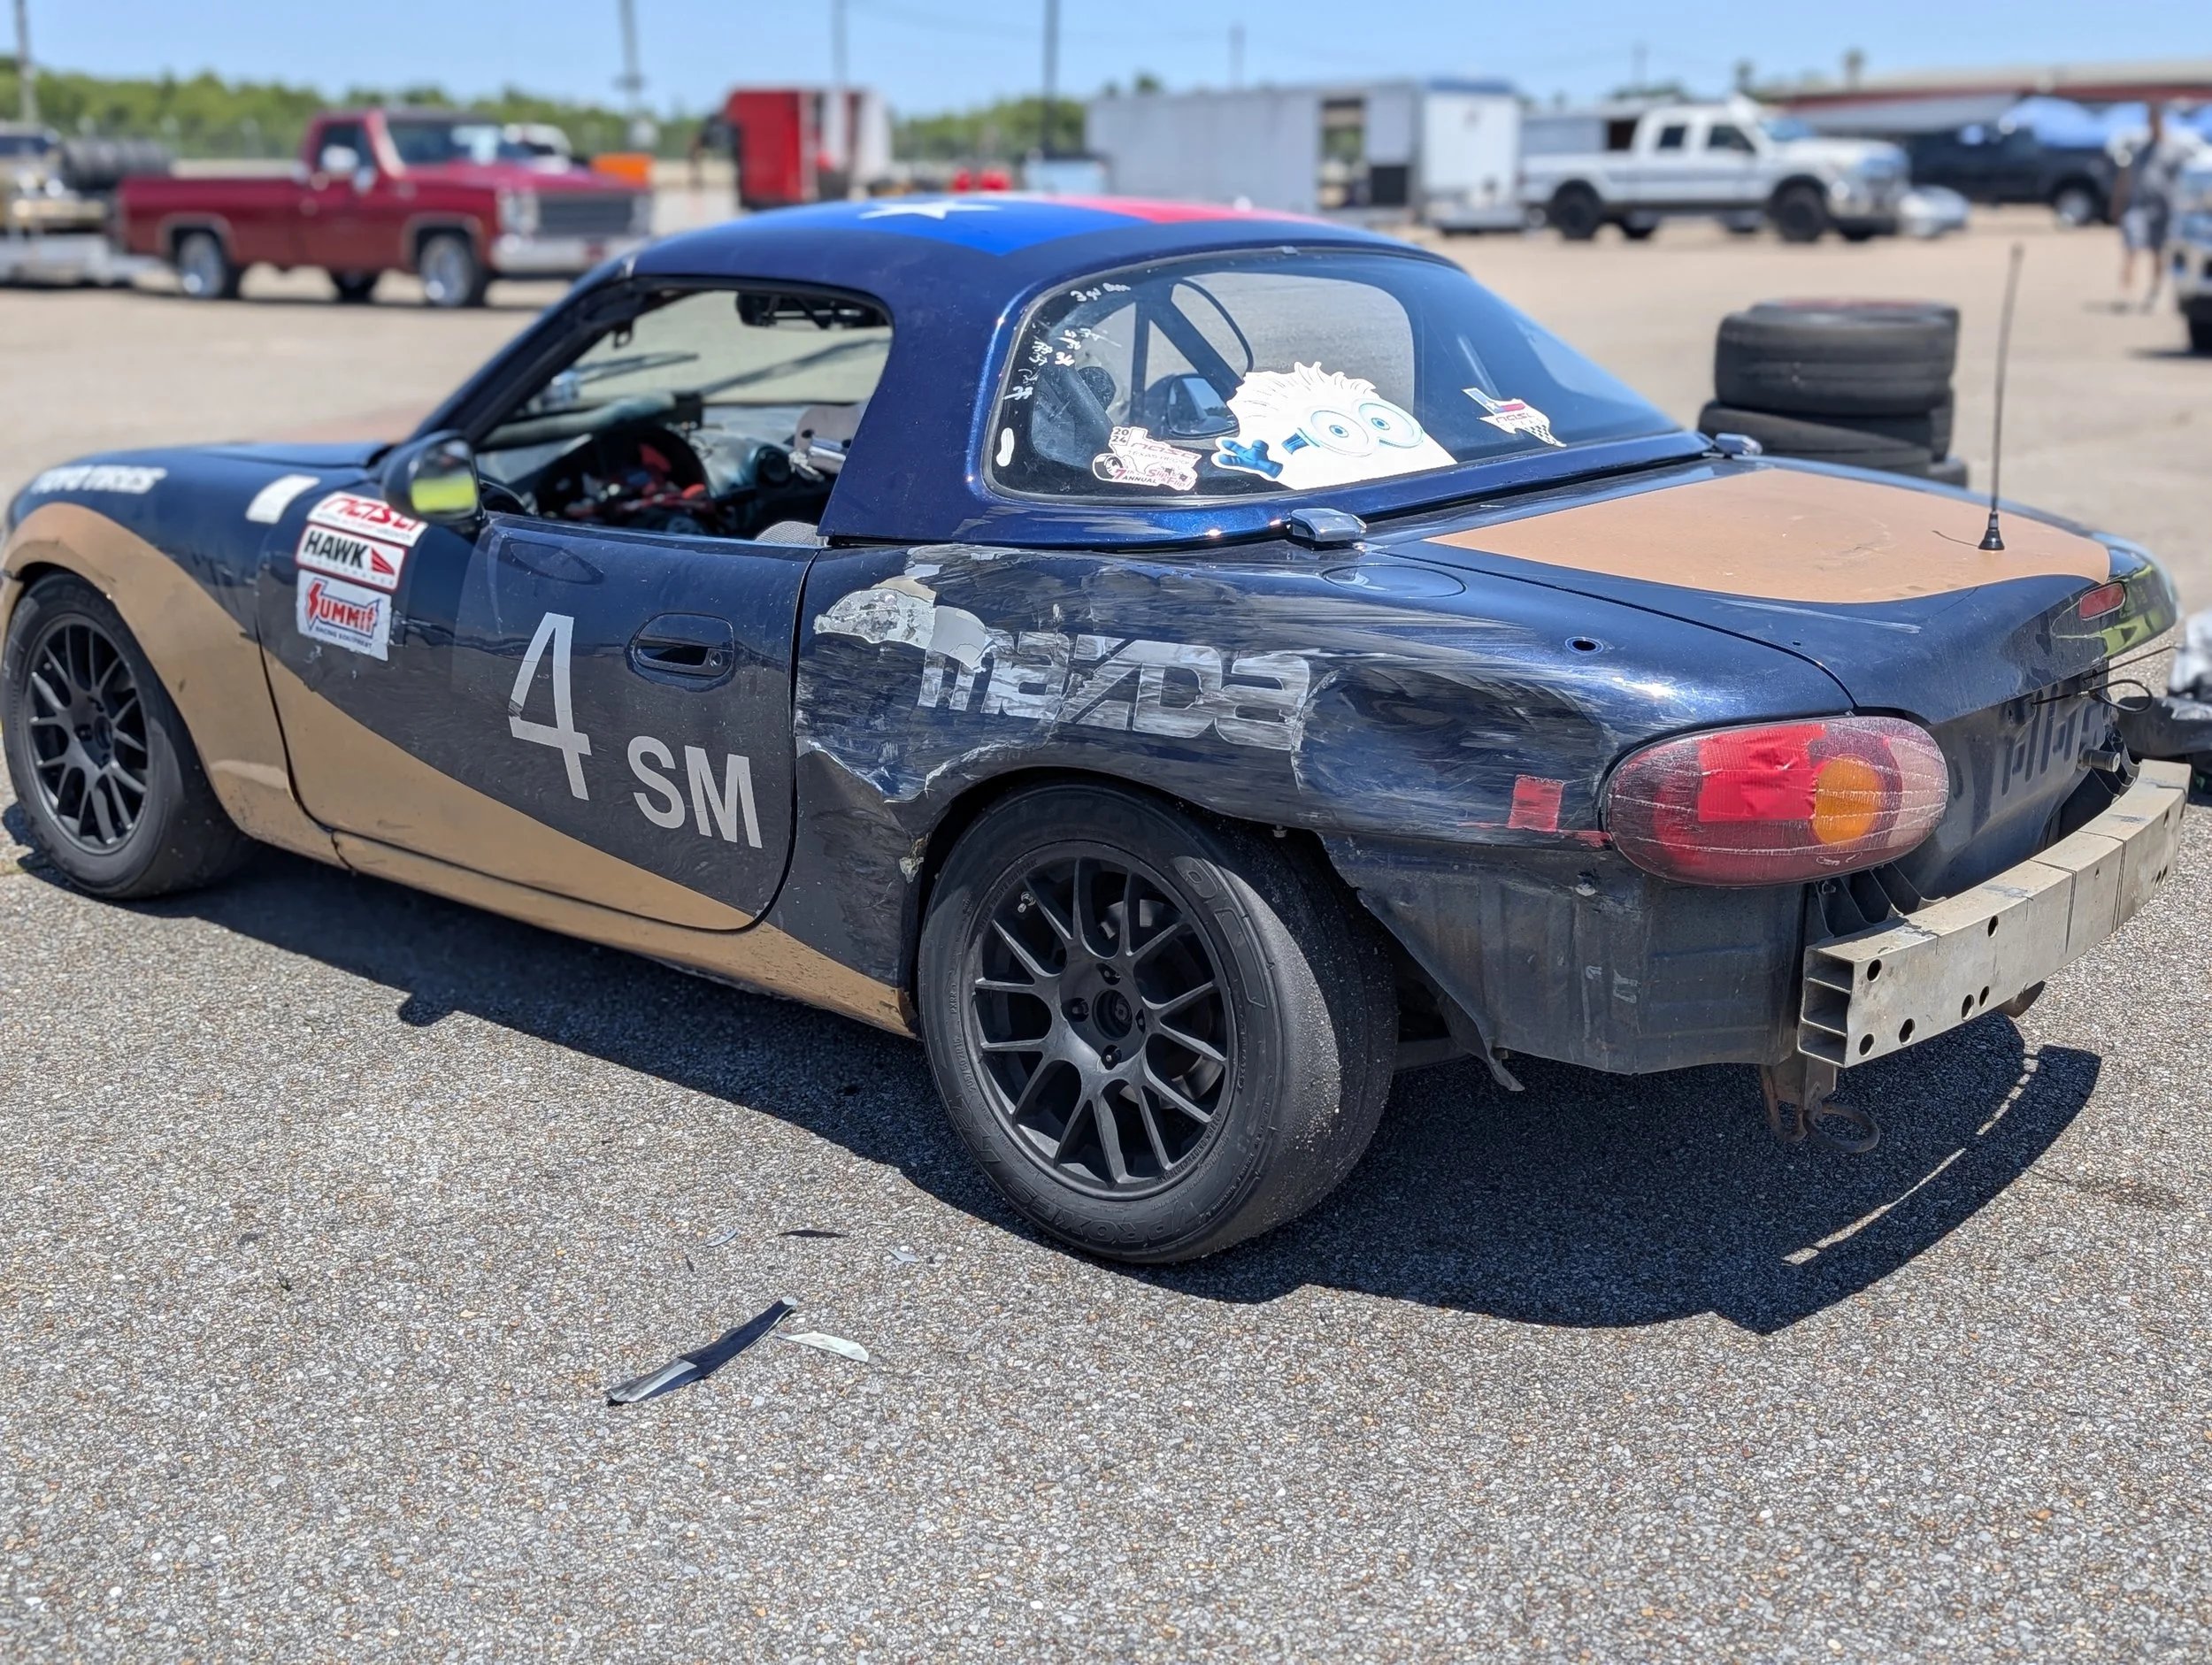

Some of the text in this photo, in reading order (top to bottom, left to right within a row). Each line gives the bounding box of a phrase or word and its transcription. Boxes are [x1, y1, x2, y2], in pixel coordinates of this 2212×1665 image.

[303, 530, 369, 569] HAWK
[315, 626, 338, 639] RACING
[508, 611, 592, 801] 4
[627, 735, 763, 848] SM
[1204, 1110, 1223, 1141] WHEELS
